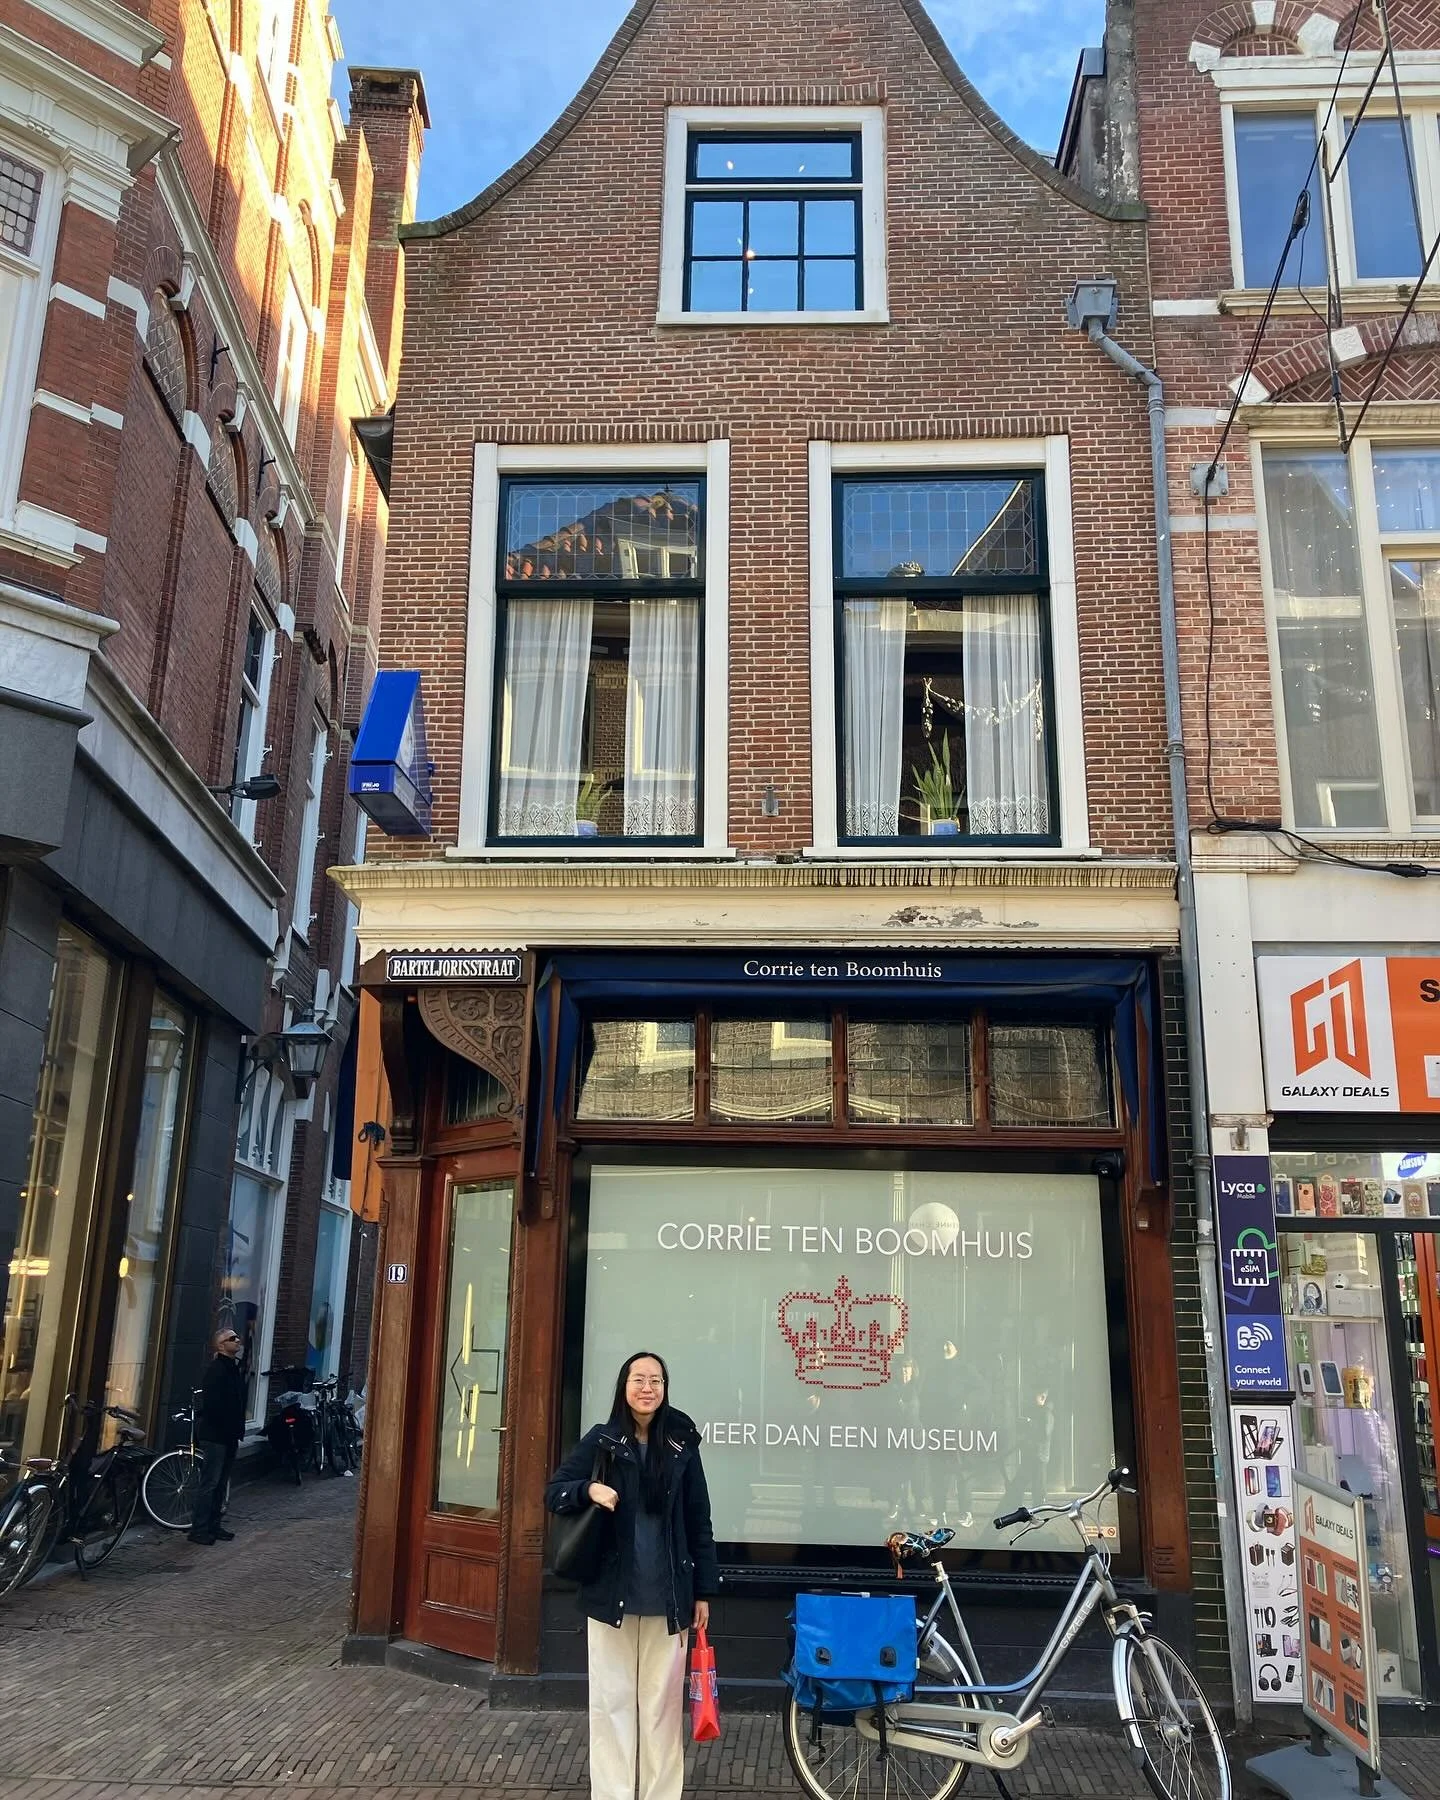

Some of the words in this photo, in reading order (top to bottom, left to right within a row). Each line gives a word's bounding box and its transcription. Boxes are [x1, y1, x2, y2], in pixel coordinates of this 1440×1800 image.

[392, 959, 515, 977] BARTELJORISSTRAAT
[744, 960, 804, 978] Corrie
[810, 962, 839, 977] ten
[846, 960, 942, 978] Boomhuis
[1281, 1086, 1340, 1097] GALAXY
[1343, 1086, 1389, 1097] DEALS
[1400, 1156, 1425, 1170] SAMSUNG
[1221, 1181, 1255, 1195] Lyca
[657, 1223, 772, 1252] CORRIE
[781, 1225, 844, 1254] TEN
[856, 1227, 1033, 1259] BOOMHUIS
[391, 1267, 405, 1281] 19
[1240, 1264, 1260, 1273] eSIM
[1235, 1365, 1271, 1374] Connect
[1235, 1379, 1255, 1387] your
[1257, 1377, 1282, 1386] world
[765, 1423, 820, 1447] DAN
[829, 1425, 878, 1448] EEN
[887, 1426, 998, 1452] MUSEUM
[1315, 1515, 1335, 1532] GALAXY
[1336, 1524, 1354, 1540] DEALS
[1060, 1600, 1095, 1649] GAZELLE
